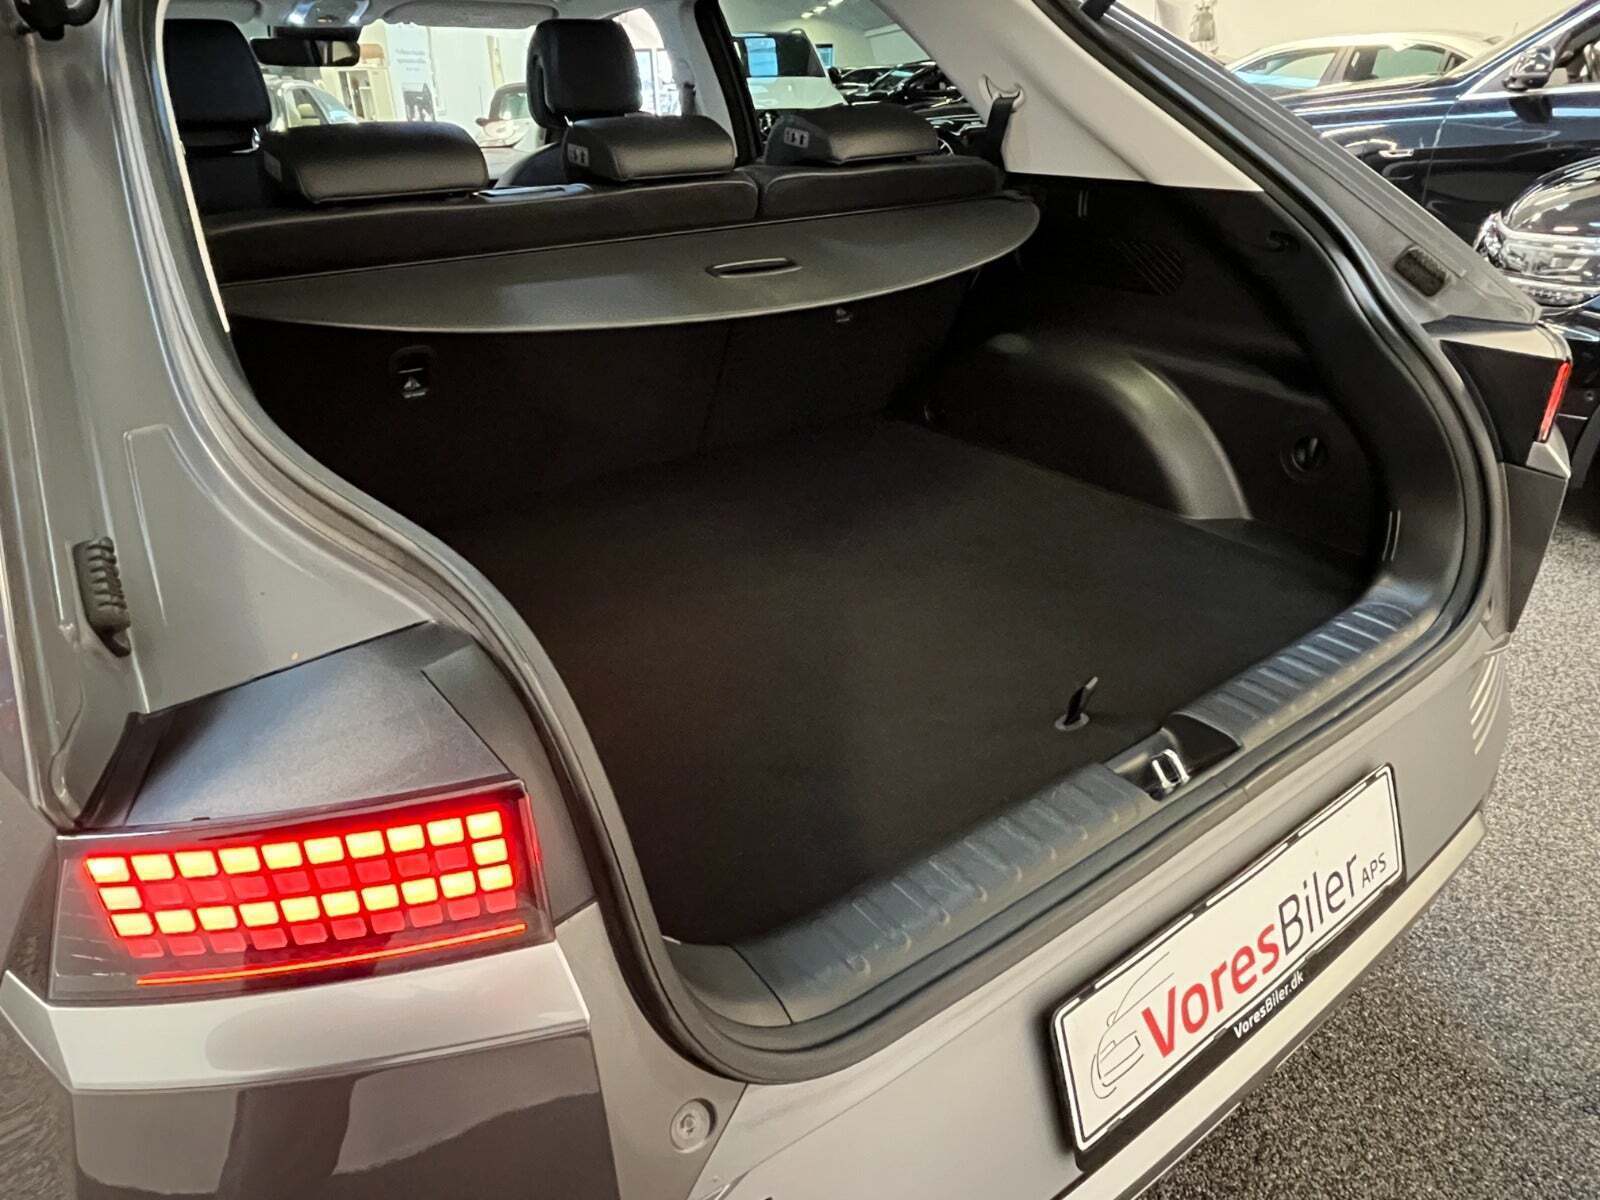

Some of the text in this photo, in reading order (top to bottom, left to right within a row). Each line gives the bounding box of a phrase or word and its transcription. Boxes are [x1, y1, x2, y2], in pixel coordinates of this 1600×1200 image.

[1142, 852, 1386, 1058] VoresBiler APS
[1233, 970, 1304, 1038] VoresBiler.dk
